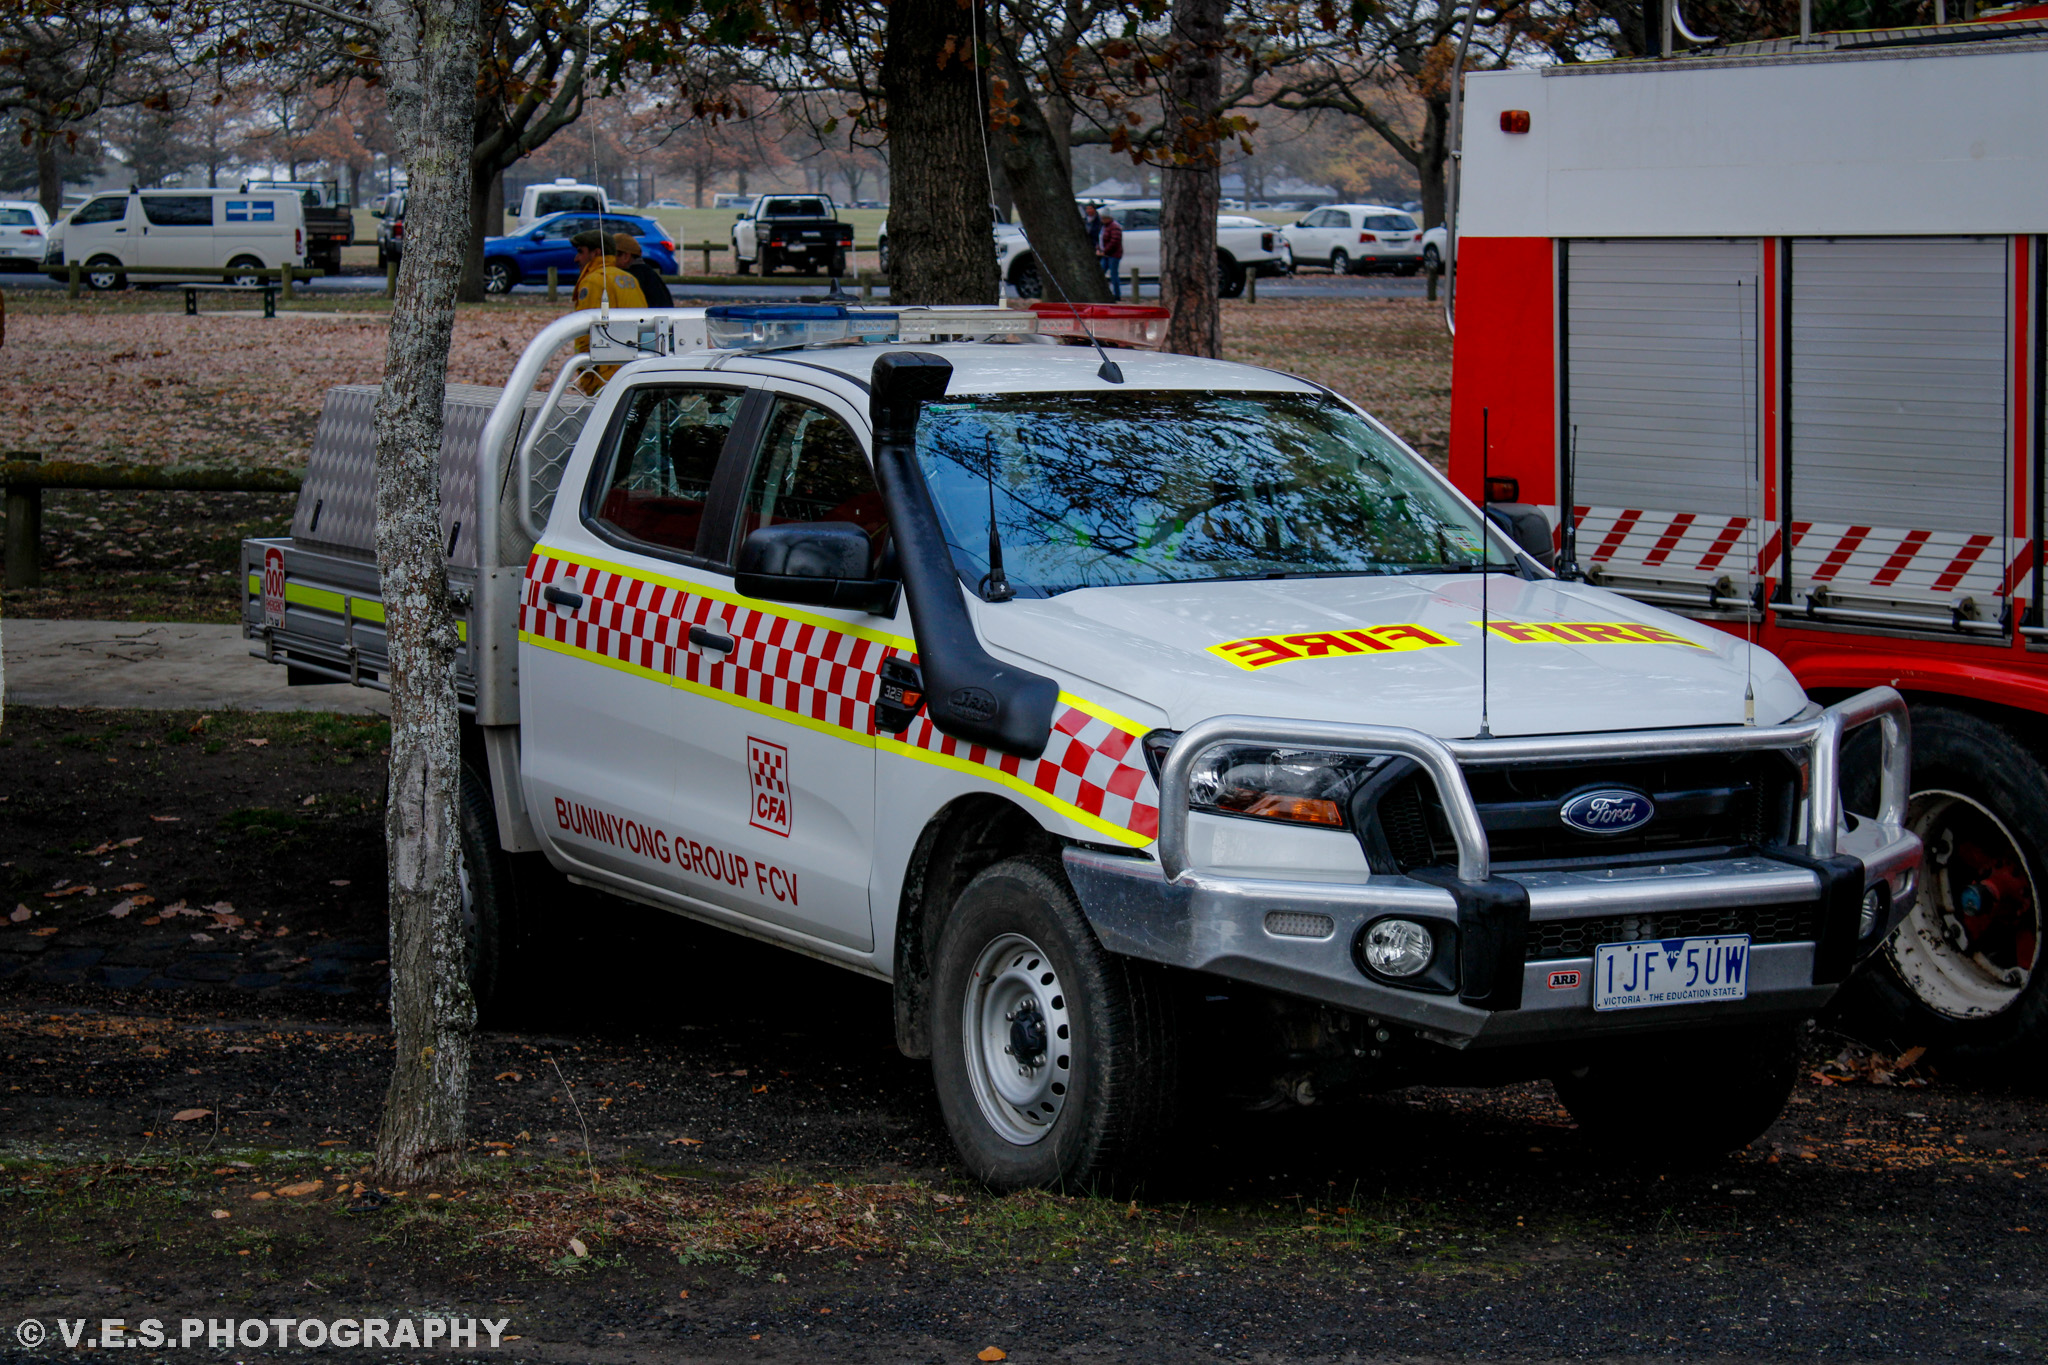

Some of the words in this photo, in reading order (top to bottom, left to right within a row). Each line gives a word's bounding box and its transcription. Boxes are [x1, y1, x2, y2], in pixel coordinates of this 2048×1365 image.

[265, 568, 284, 598] 000
[1485, 622, 1705, 648] FIRE
[756, 792, 787, 826] CFA
[1586, 798, 1636, 824] Ford
[554, 796, 672, 865] BUNINYONG
[674, 836, 749, 889] GROUP
[754, 861, 799, 907] FCV
[1666, 950, 1680, 960] VIC
[1551, 974, 1577, 986] ARB
[1606, 951, 1659, 994] 1JF
[1685, 945, 1745, 987] 5UW
[1603, 995, 1641, 1006] VICTORIA
[1649, 993, 1664, 1002] THE
[1666, 988, 1711, 1000] EDUCATION
[1713, 987, 1737, 997] STATE
